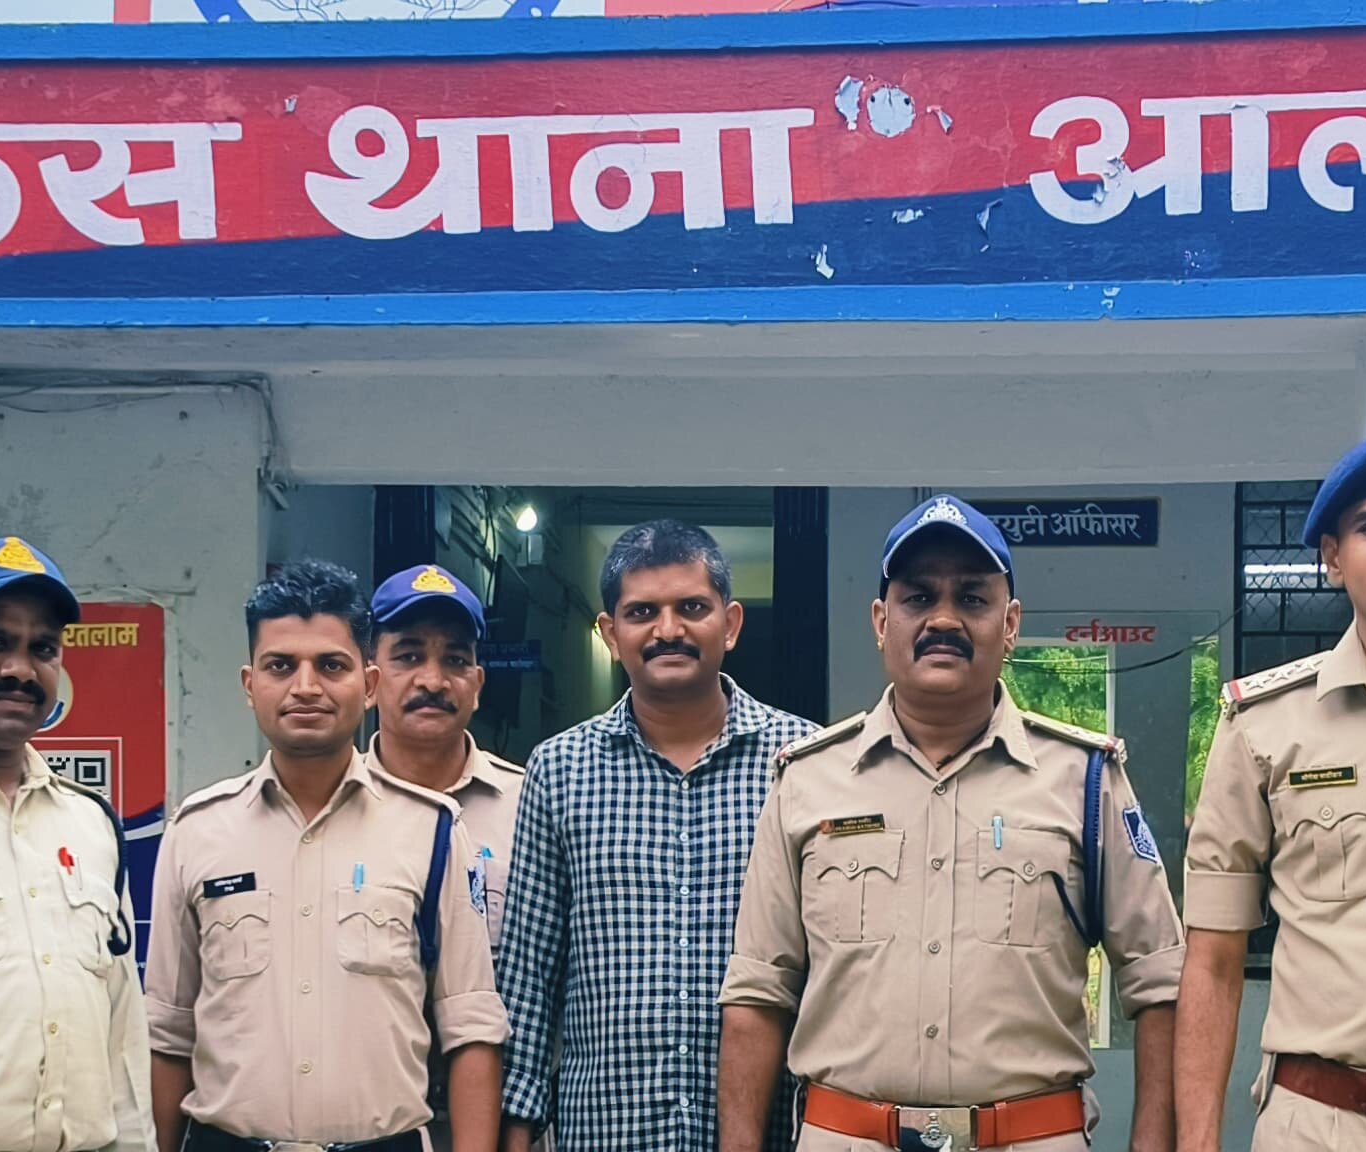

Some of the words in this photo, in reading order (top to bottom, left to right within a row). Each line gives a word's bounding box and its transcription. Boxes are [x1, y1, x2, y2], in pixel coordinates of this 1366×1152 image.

[305, 106, 816, 240] थाना
[62, 623, 139, 646] रतलाम
[1065, 618, 1156, 643] टर्नआउट
